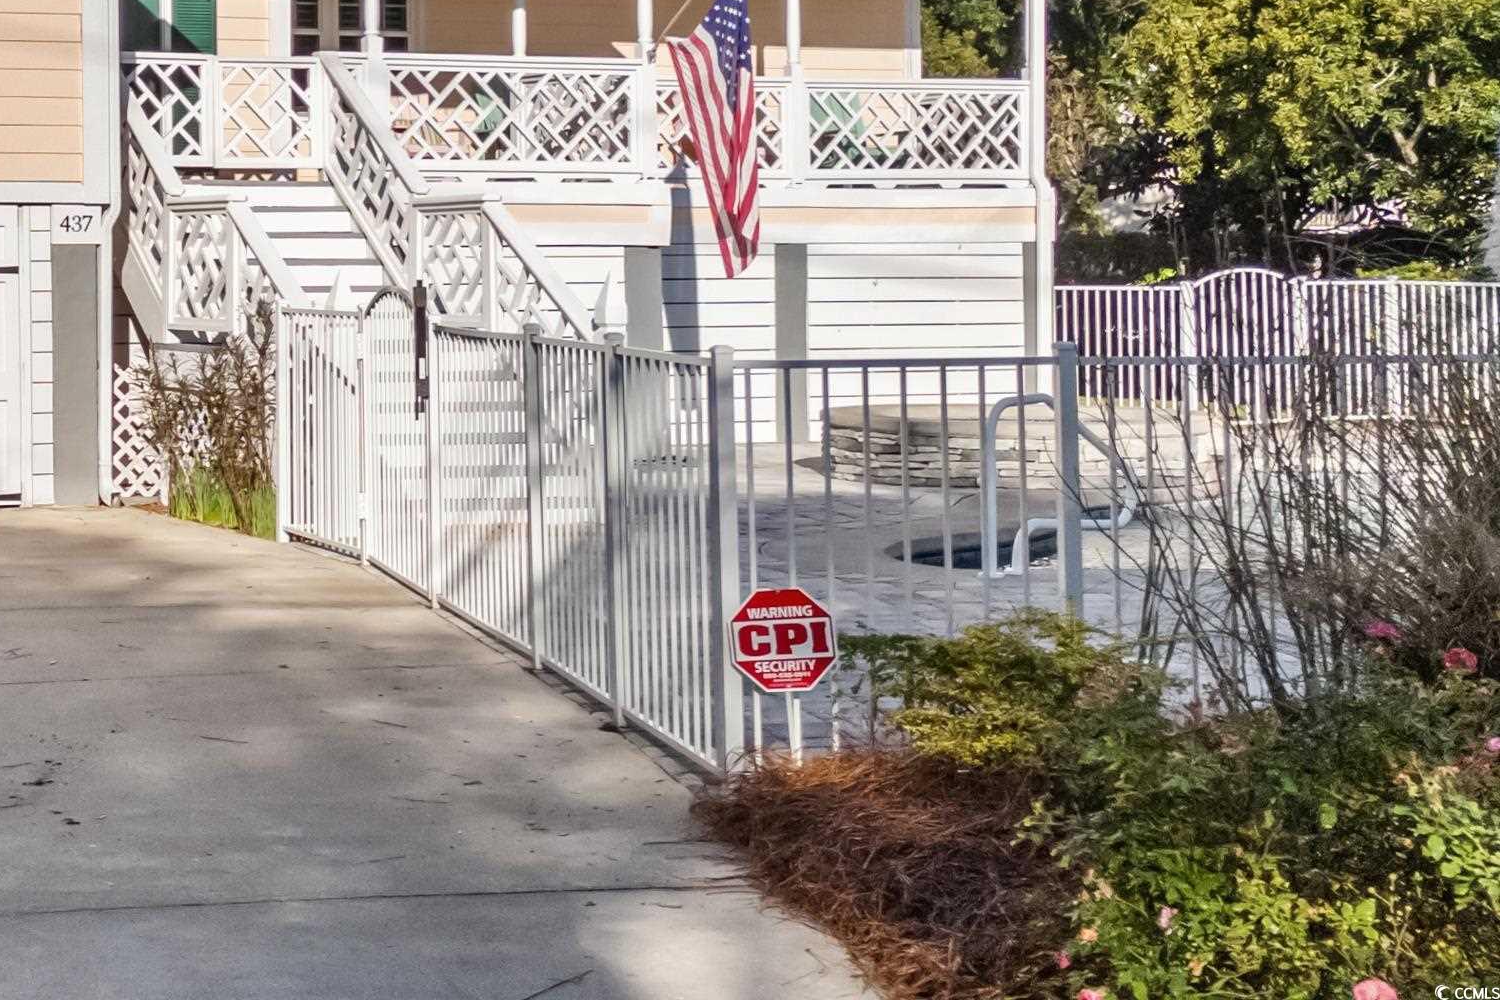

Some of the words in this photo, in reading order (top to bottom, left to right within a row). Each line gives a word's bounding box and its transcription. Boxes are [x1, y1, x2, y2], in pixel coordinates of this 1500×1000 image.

[60, 215, 93, 232] 437
[746, 605, 812, 619] WARNING
[738, 622, 829, 656] CPI
[754, 660, 816, 673] SECURITY
